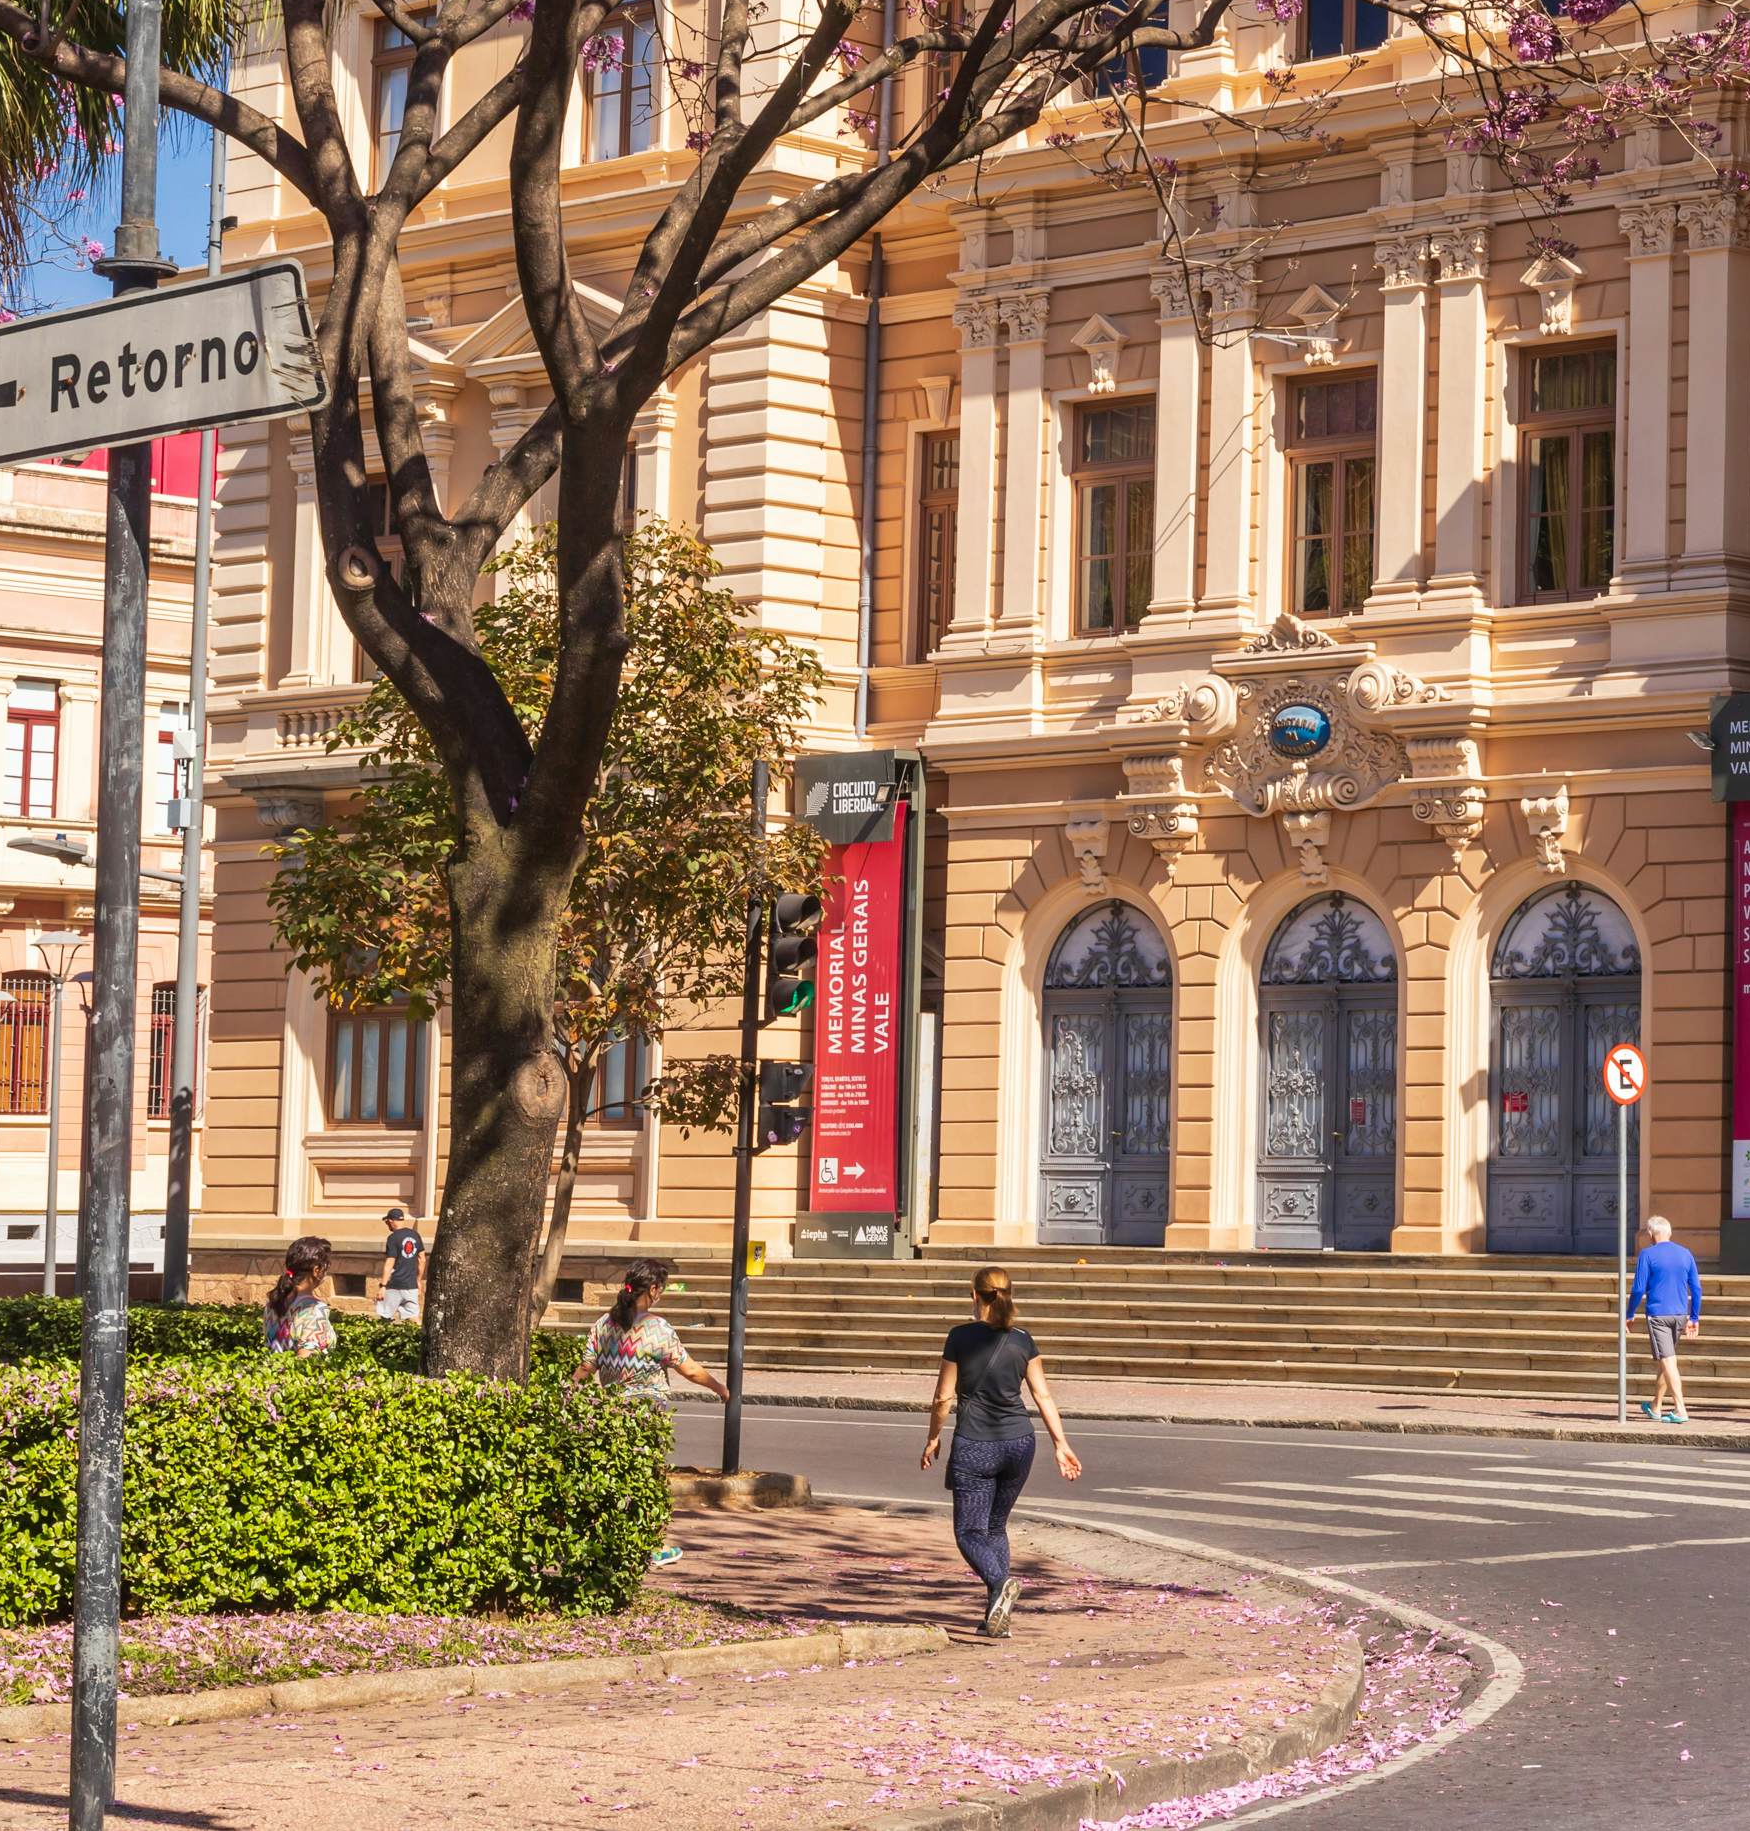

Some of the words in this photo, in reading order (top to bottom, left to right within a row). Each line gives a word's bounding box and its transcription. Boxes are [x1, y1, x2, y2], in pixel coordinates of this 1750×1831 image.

[50, 330, 259, 413] Retorno
[832, 780, 876, 798] CIRCUITO
[852, 879, 869, 967] GERAIS
[828, 921, 845, 1054] MEMORIAL
[850, 973, 868, 1054] MINAS
[873, 992, 890, 1054] VALE
[866, 1225, 888, 1235] MINAS
[866, 1234, 888, 1242] GERAIS
